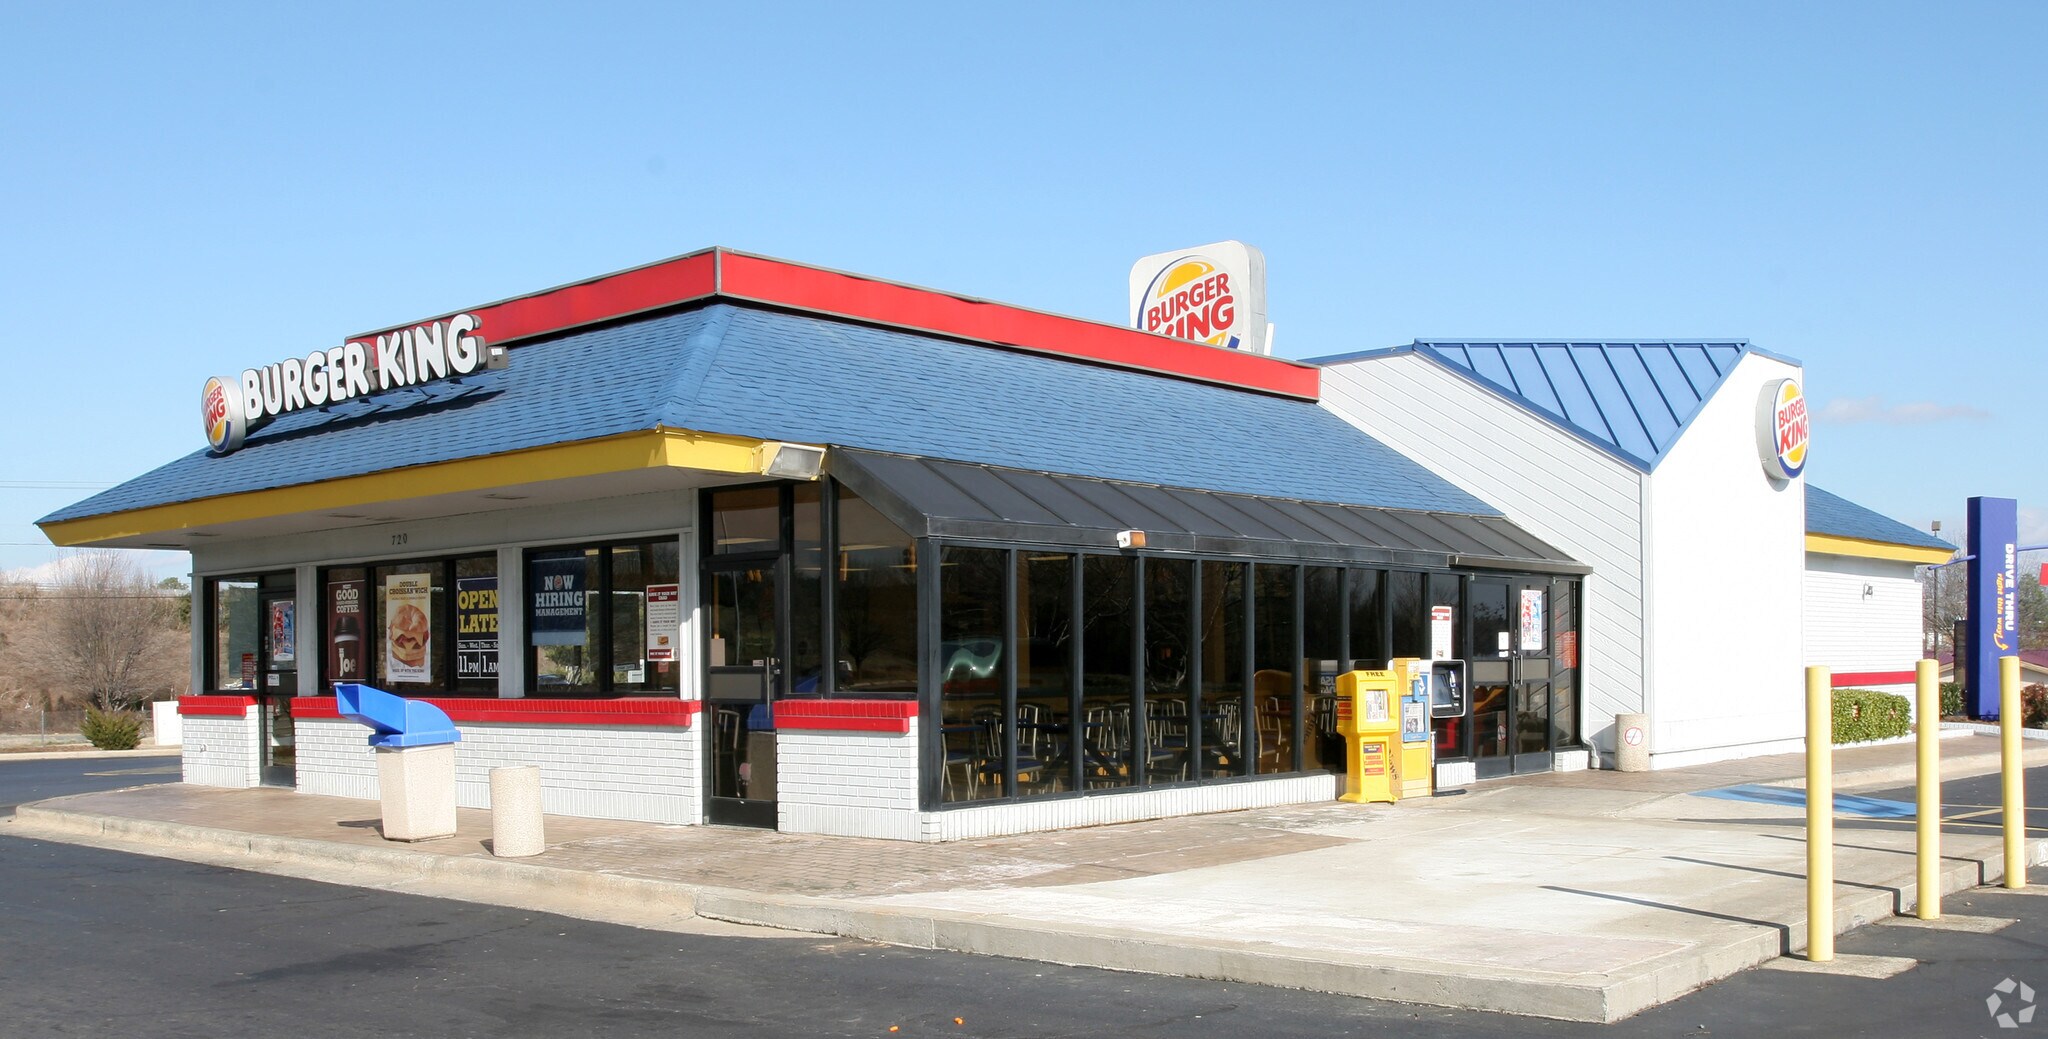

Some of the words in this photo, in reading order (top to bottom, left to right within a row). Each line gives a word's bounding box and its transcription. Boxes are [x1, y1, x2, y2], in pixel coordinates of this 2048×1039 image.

[1147, 272, 1230, 332] BURGER
[241, 341, 373, 420] BURGER
[376, 313, 481, 390] KING
[1780, 415, 1807, 455] KING
[391, 533, 408, 545] 720
[2005, 543, 2015, 588] DRIVE
[544, 574, 574, 590] NOW
[1996, 573, 2004, 595] right
[336, 588, 359, 601] GOOD
[458, 589, 499, 610] OPEN
[535, 591, 584, 607] HIRING
[535, 607, 584, 617] MANAGEMENT
[2005, 592, 2015, 631] THRU
[459, 613, 499, 633] LATE
[339, 653, 357, 677] Joe
